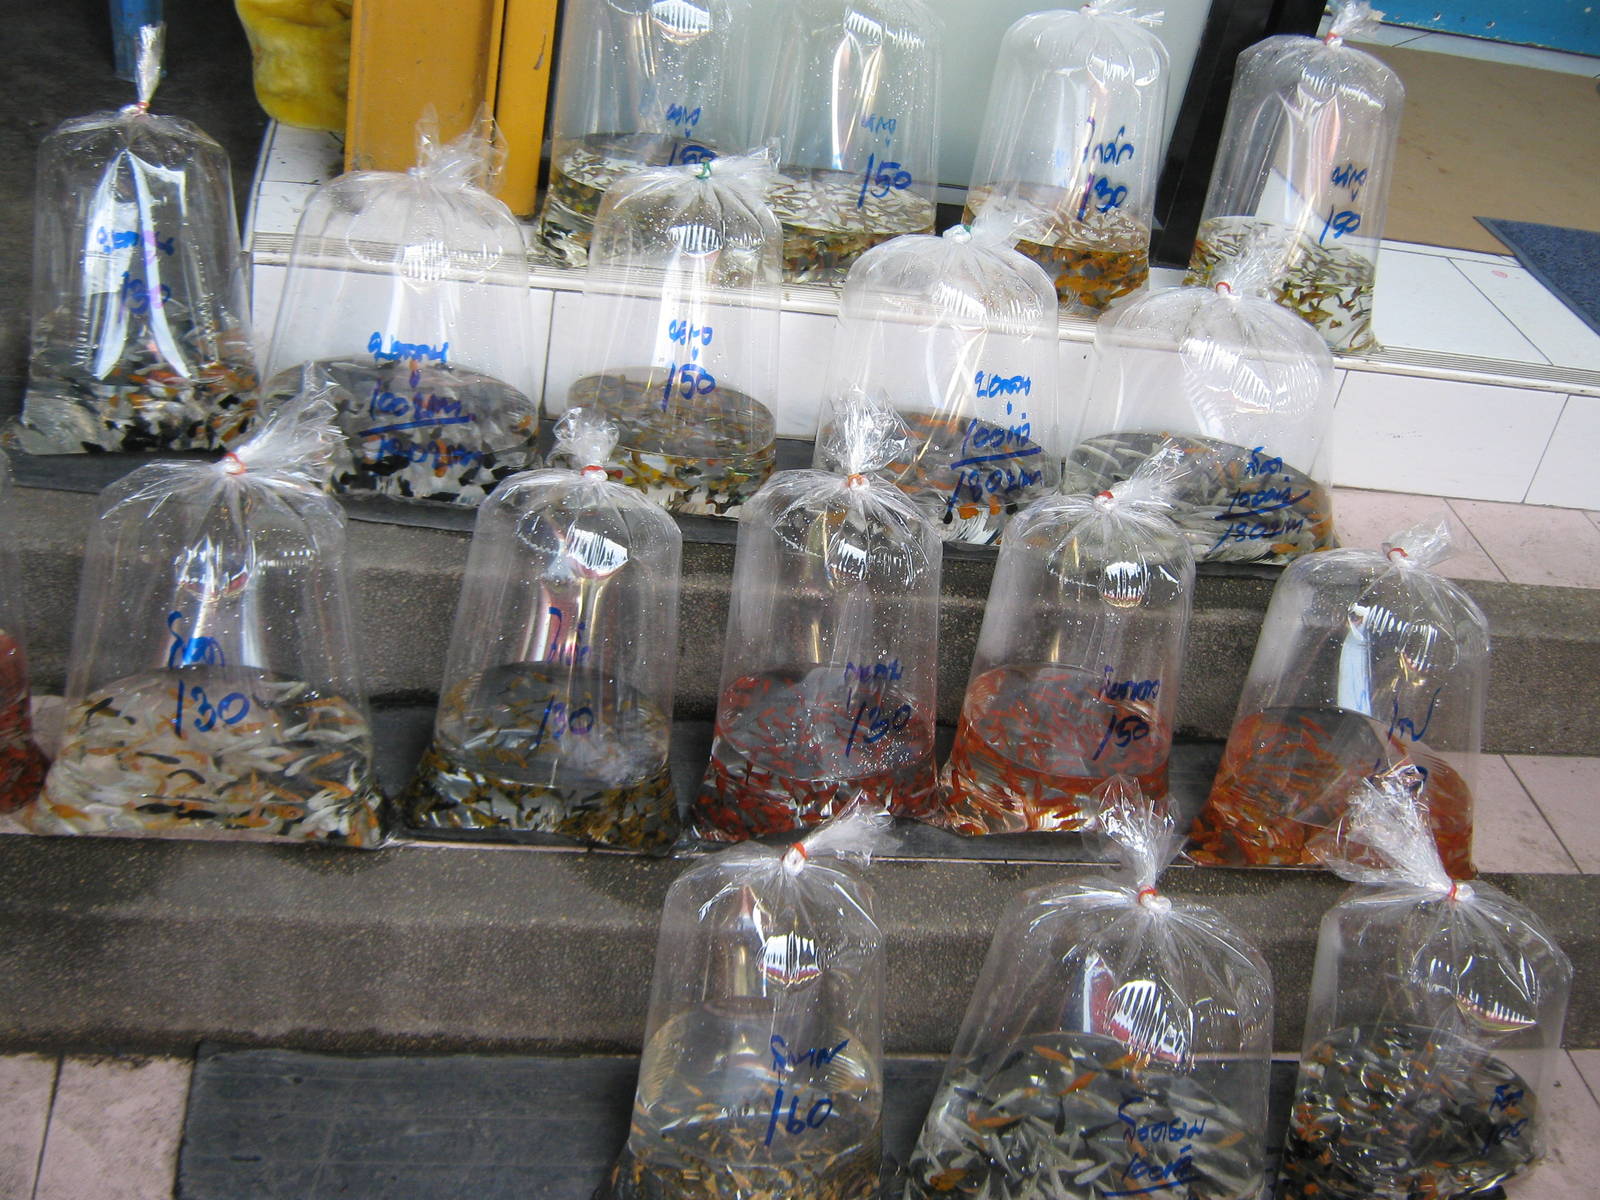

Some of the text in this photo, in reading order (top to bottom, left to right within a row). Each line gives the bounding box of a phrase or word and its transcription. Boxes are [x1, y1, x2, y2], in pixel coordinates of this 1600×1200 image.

[858, 152, 912, 208] 150
[1077, 173, 1128, 221] 130
[662, 362, 716, 412] 150
[175, 680, 250, 738] 130
[1092, 712, 1150, 761] 150
[764, 1086, 834, 1147] 160
